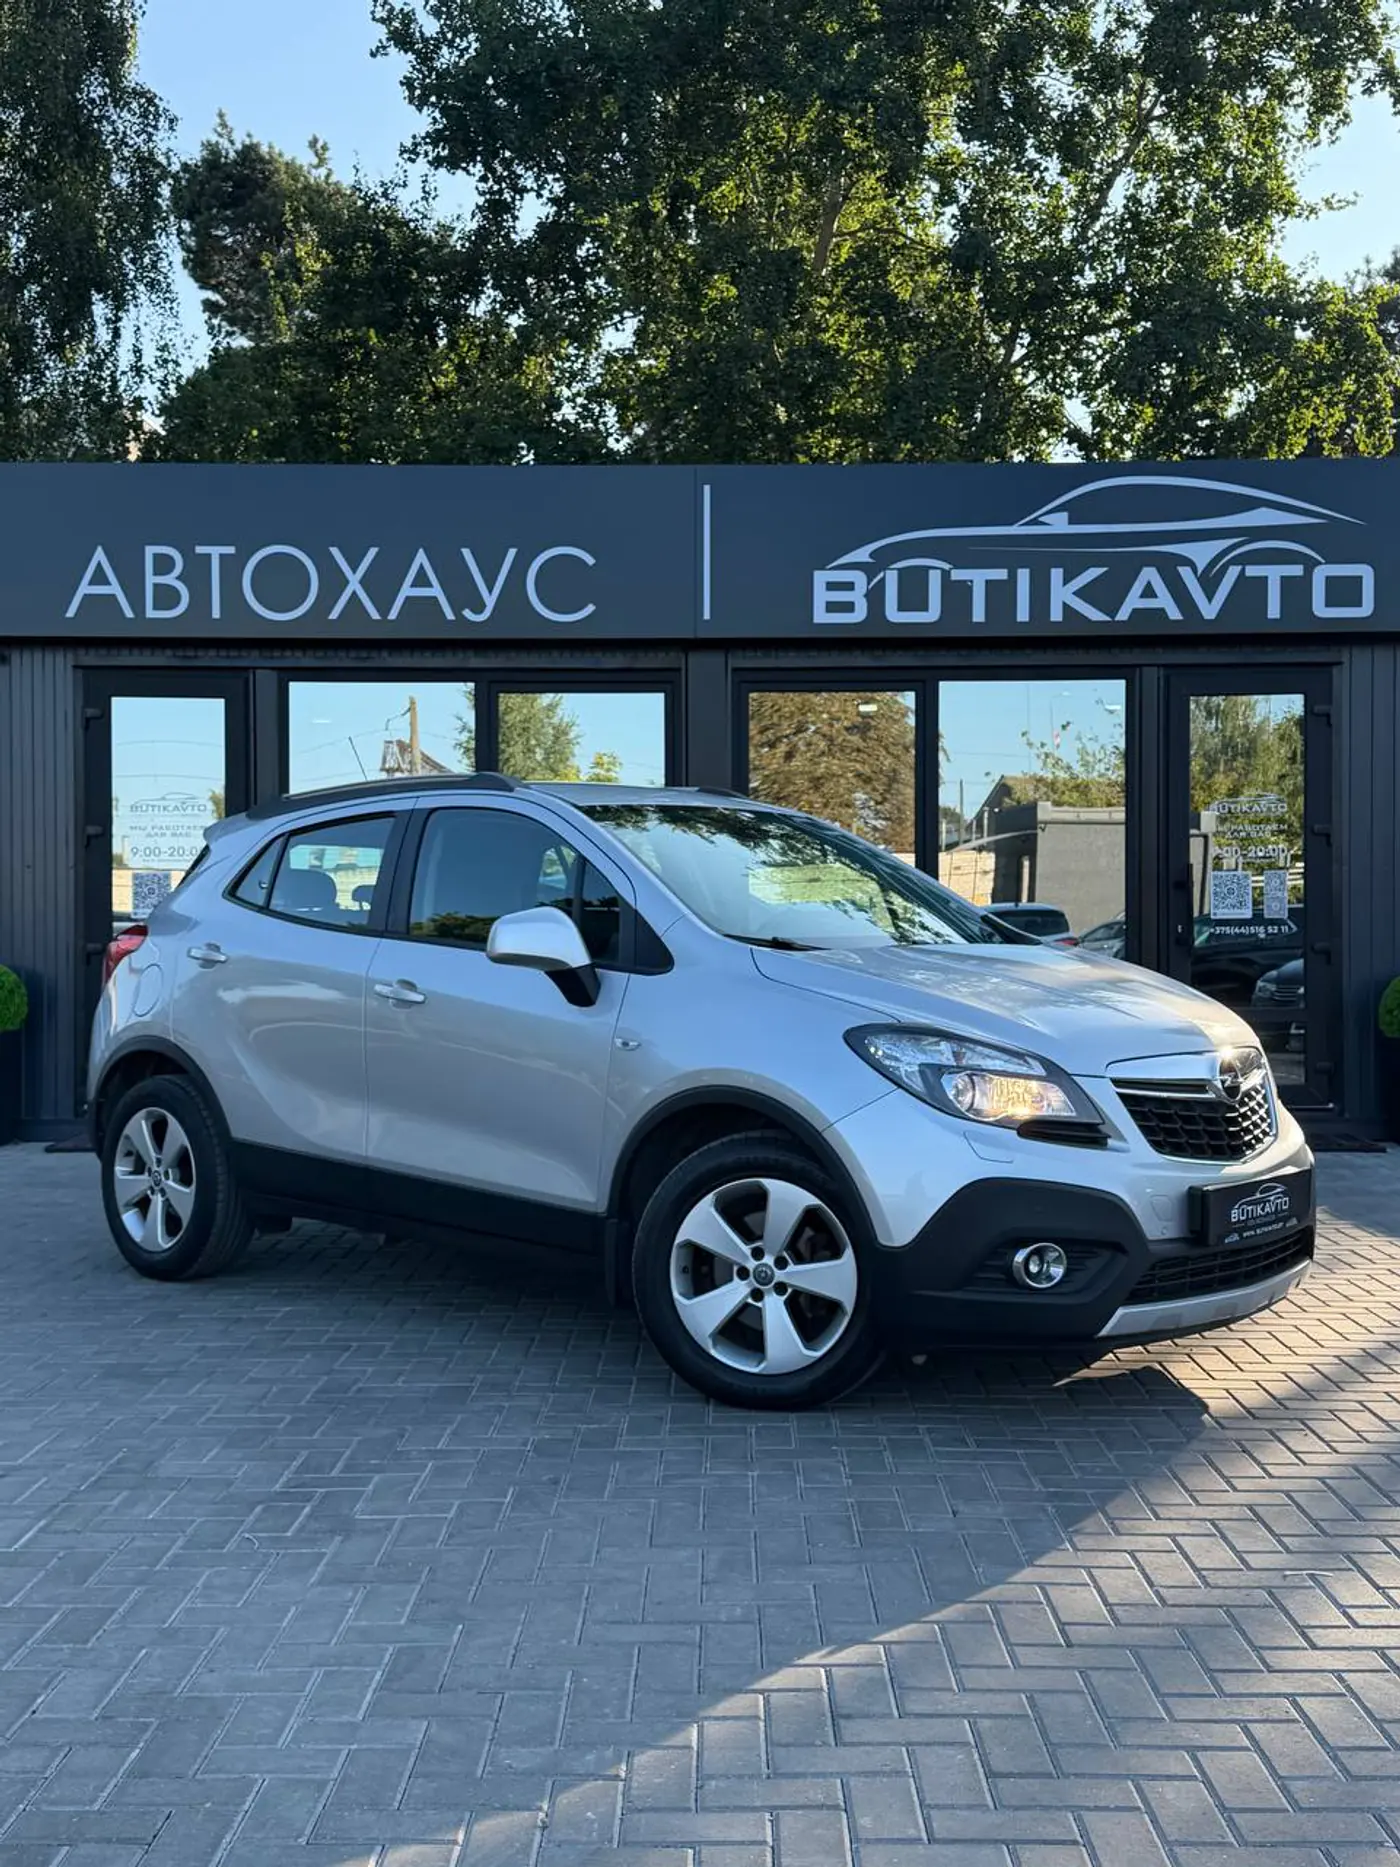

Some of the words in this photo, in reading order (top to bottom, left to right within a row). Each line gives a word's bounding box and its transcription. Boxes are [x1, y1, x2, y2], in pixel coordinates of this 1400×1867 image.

[65, 544, 597, 622] АВТОХАУС
[812, 563, 1375, 624] BUTIKAVTO
[130, 803, 207, 813] BUTIKAVTO
[130, 846, 200, 858] 9:00-20:0
[1231, 1197, 1290, 1222] BUTIKAVTO
